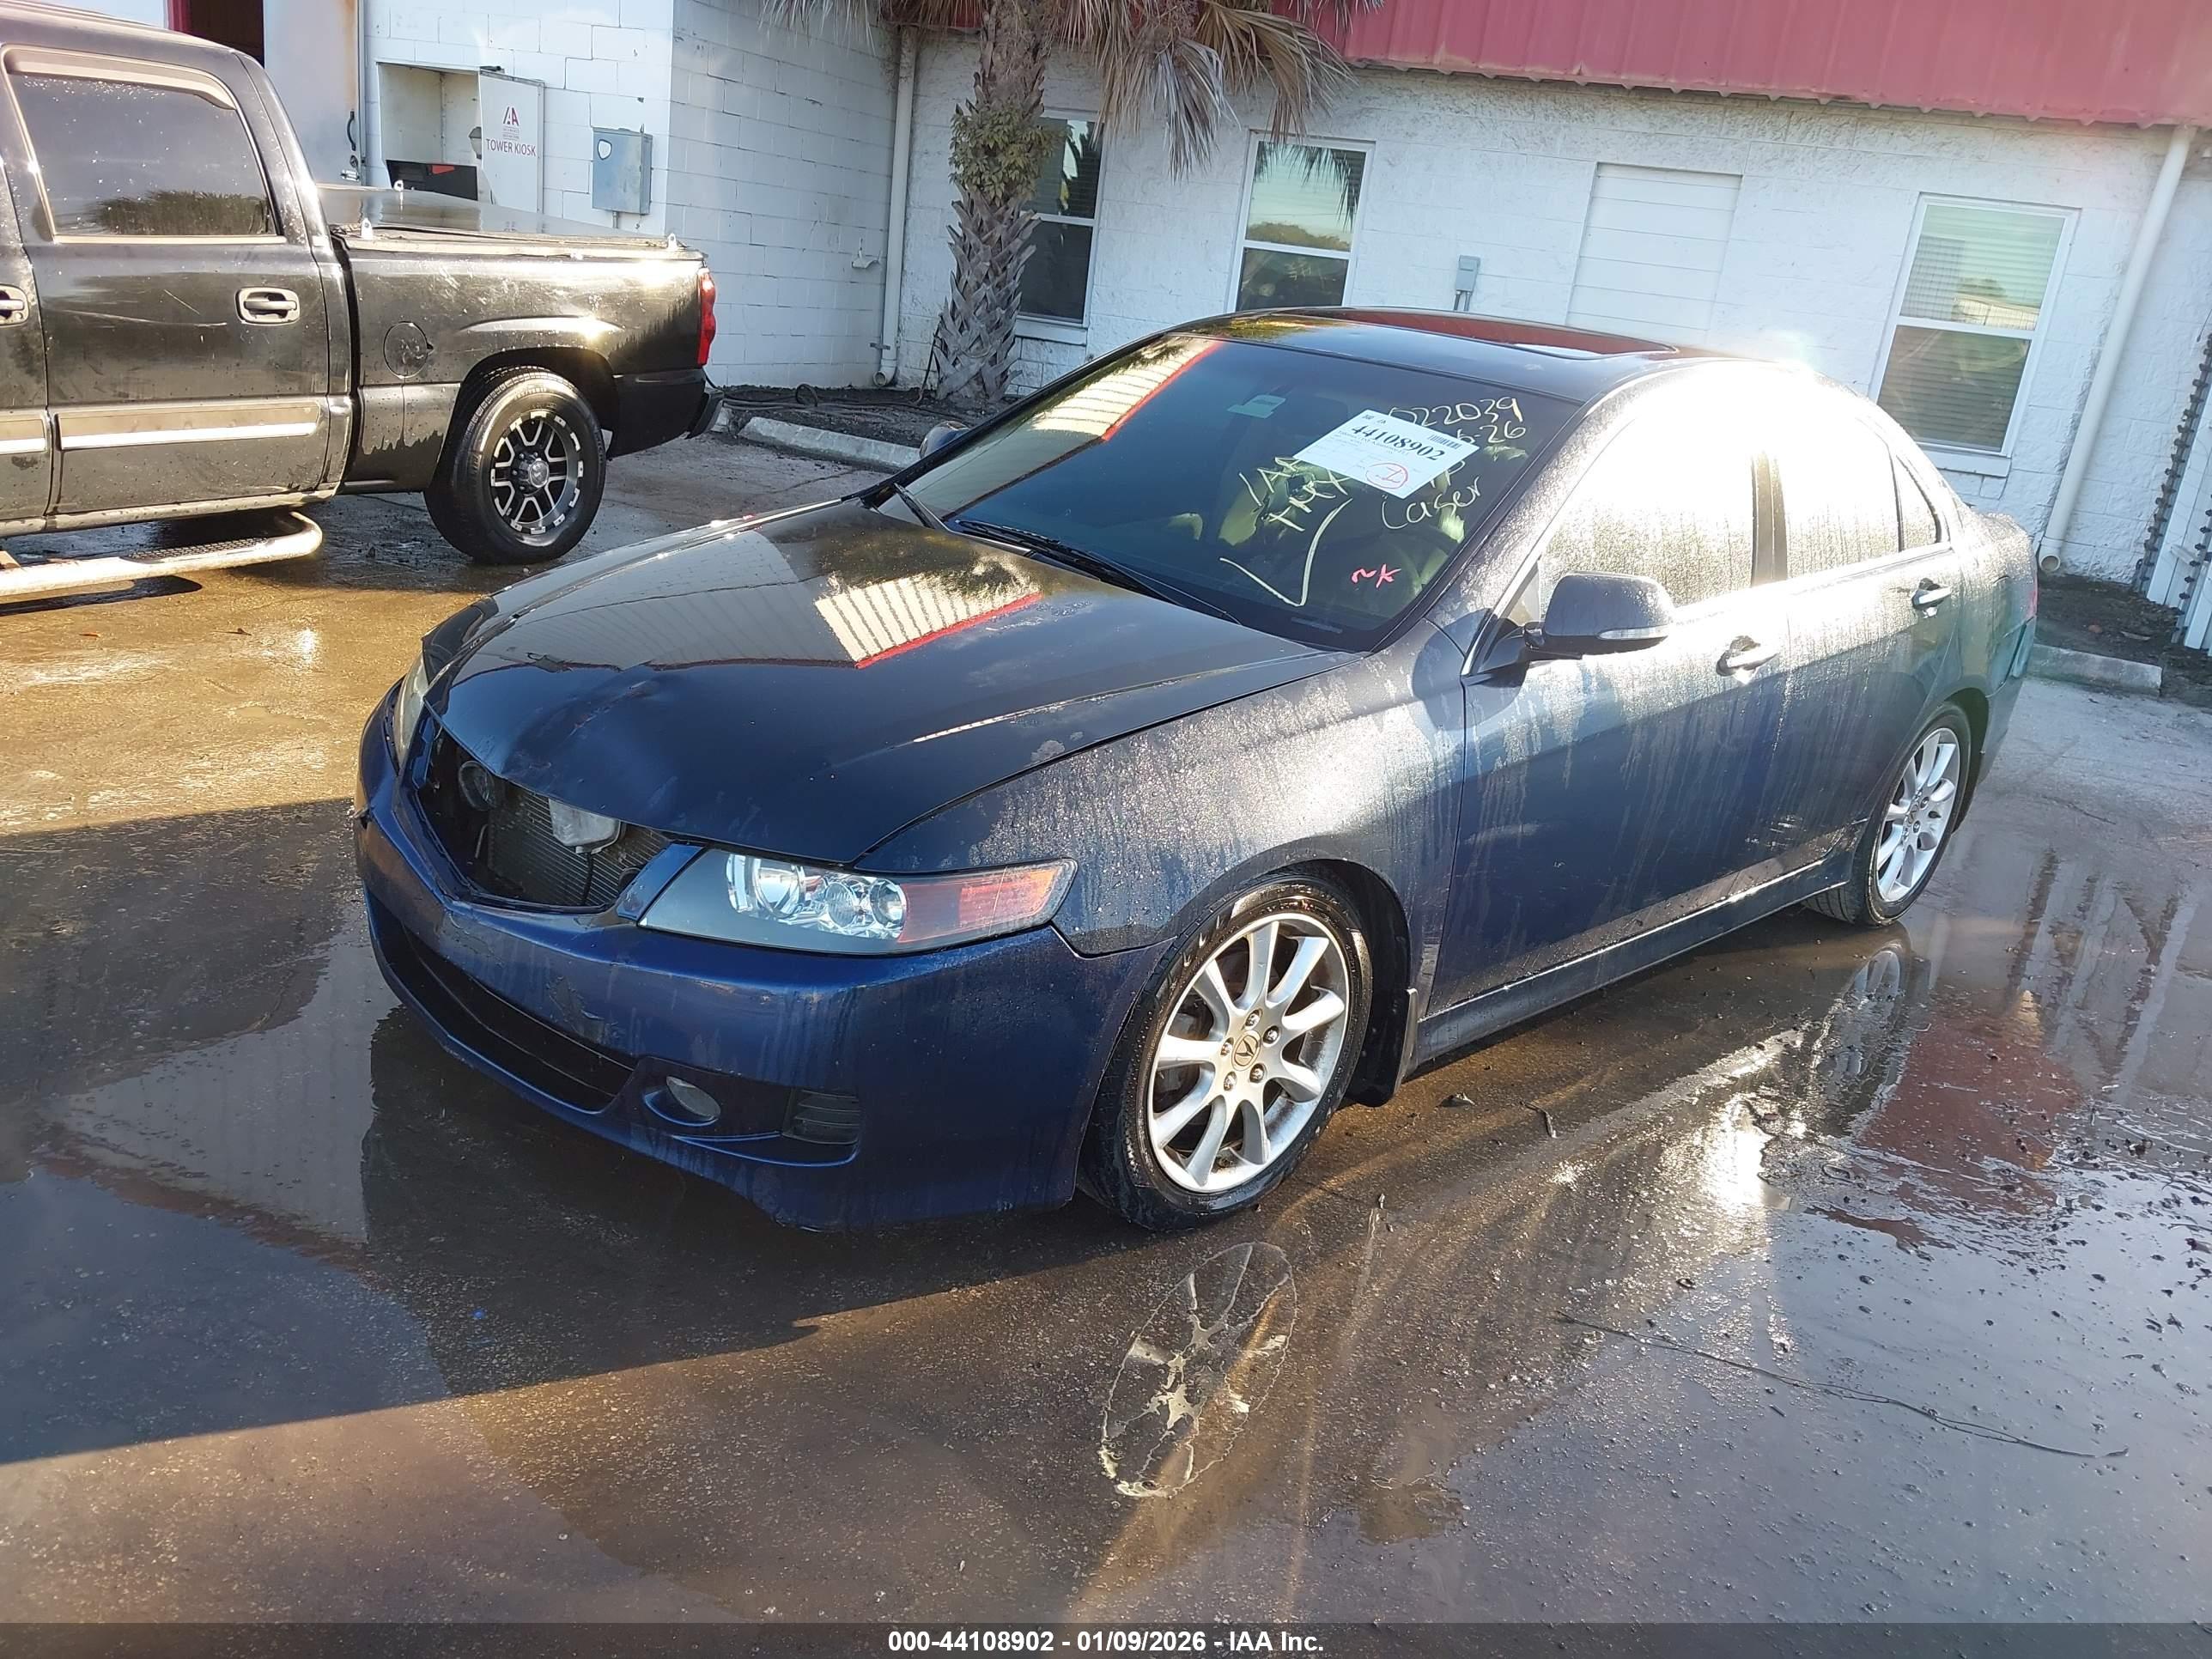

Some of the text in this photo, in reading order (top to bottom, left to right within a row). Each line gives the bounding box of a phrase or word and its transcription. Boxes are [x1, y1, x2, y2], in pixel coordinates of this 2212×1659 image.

[486, 138, 537, 156] TOWER KIOSK
[1352, 425, 1446, 461] 44108902
